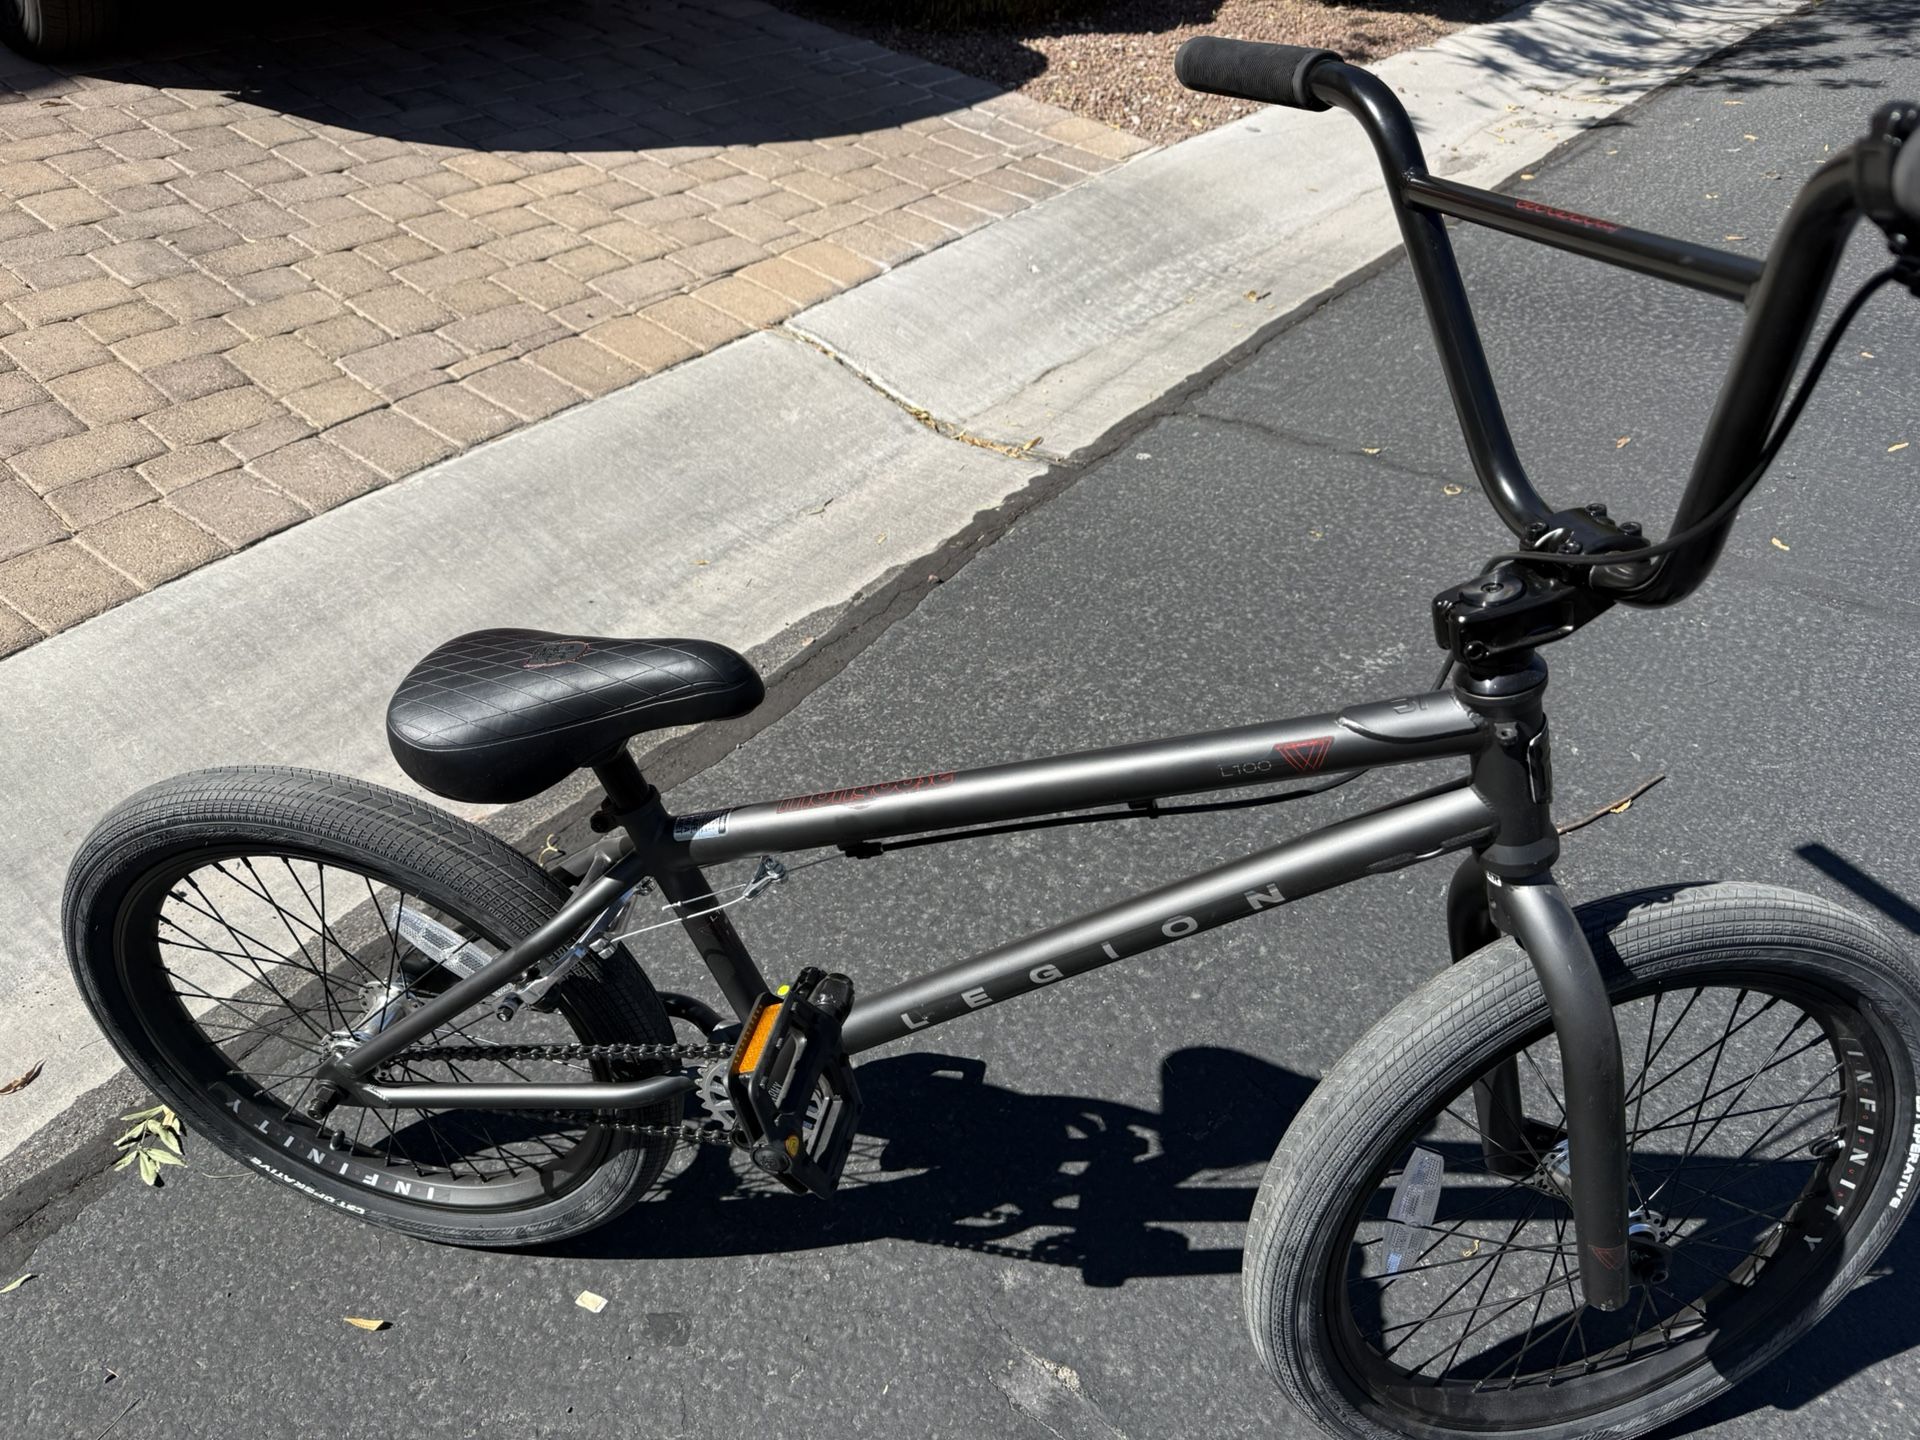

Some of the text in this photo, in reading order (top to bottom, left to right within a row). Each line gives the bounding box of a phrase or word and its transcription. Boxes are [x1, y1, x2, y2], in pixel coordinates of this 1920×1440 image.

[901, 882, 1286, 1030] LEGION
[226, 1099, 435, 1200] INFINITY
[1803, 1050, 1877, 1251] INFINITY
